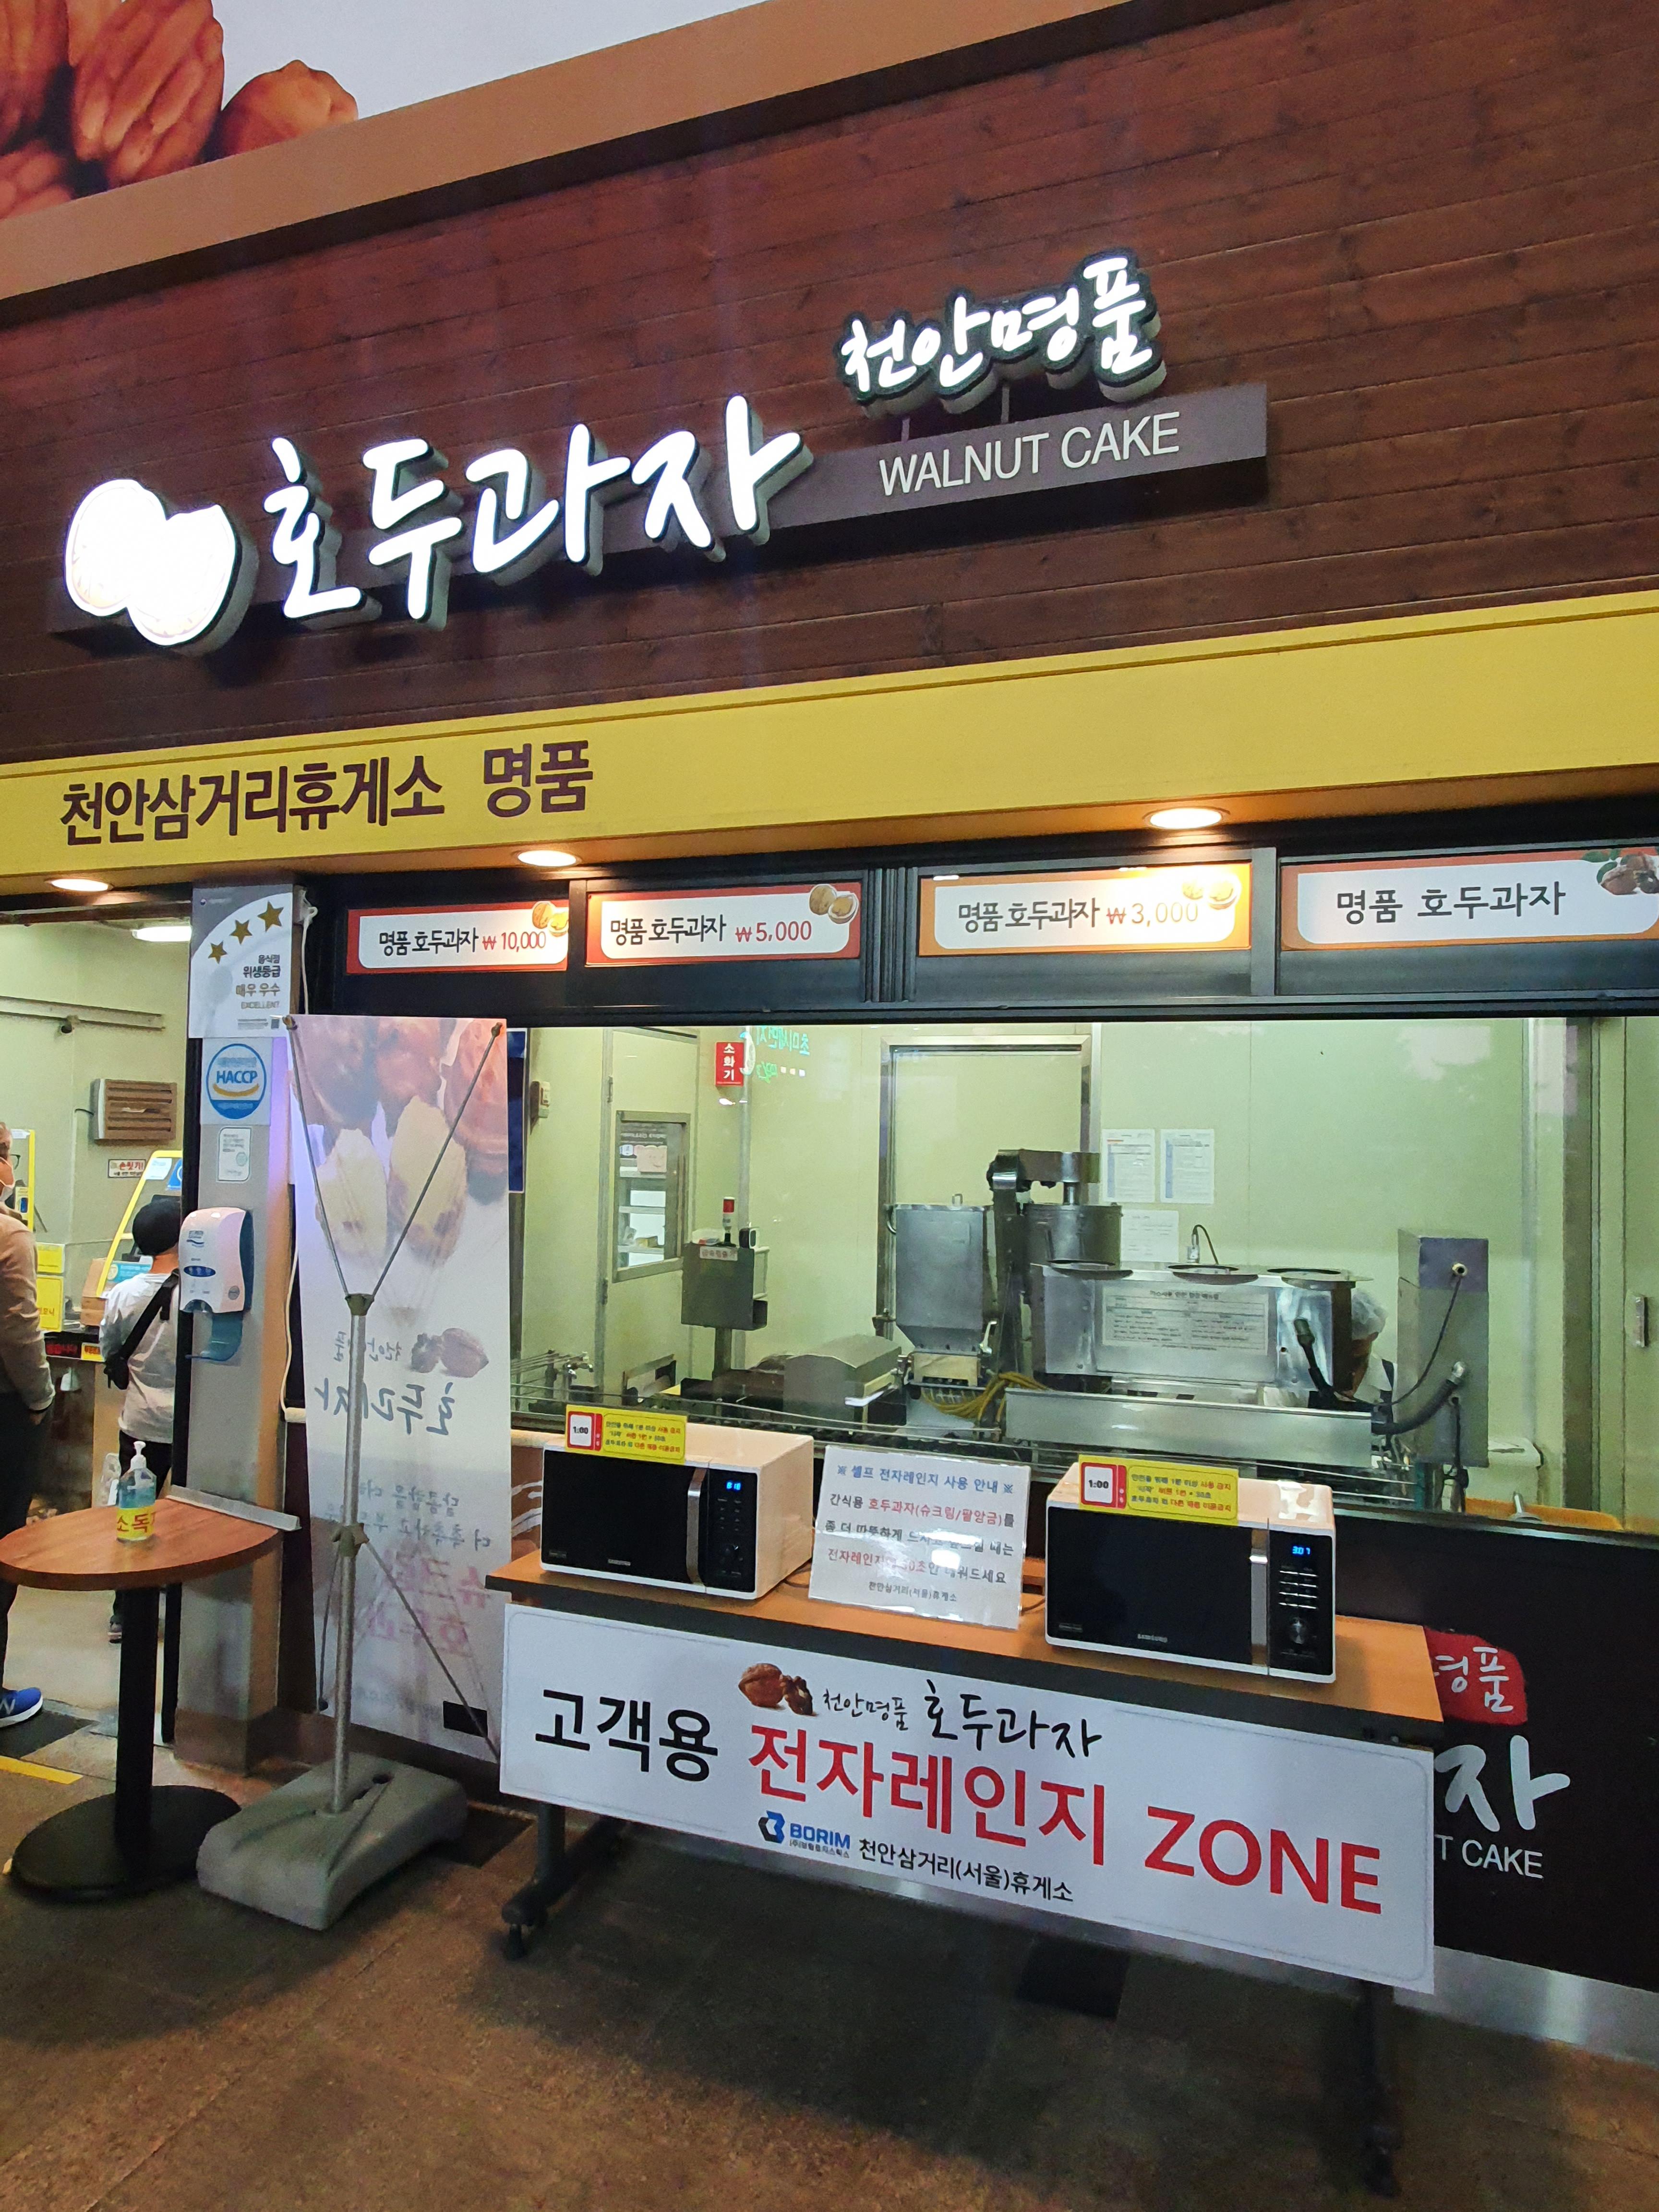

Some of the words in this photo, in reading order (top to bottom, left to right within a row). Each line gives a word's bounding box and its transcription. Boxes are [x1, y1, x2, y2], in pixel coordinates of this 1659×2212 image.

[840, 257, 1153, 393] 천안명품
[879, 433, 1049, 496] WALNUT
[1061, 411, 1180, 469] CAKE
[263, 395, 802, 620] 호두과자
[60, 755, 445, 846] 천안삼거리휴게소
[484, 740, 594, 818] 명품
[958, 902, 1003, 933] 명품
[1005, 897, 1100, 930] 호두과자
[1337, 890, 1403, 925] 명품
[1417, 881, 1566, 919] 호두과자
[379, 930, 411, 956] 명품
[412, 927, 479, 954] 호두과자
[610, 918, 647, 946] 명품
[649, 914, 727, 944] 호두과자
[243, 965, 281, 978] 위생등급
[259, 983, 280, 997] 우수
[216, 1070, 258, 1084] HACCP
[723, 1043, 736, 1081] 소화기
[851, 1465, 874, 1479] 셀프
[879, 1468, 939, 1486] 전자레인지
[944, 1475, 969, 1491] 사용
[974, 1478, 998, 1494] 안내
[1088, 1479, 1109, 1489] 1:00
[830, 1493, 863, 1509] 간식용
[841, 1522, 851, 1533] 더
[822, 1688, 909, 1731] 천안명품
[923, 1679, 1103, 1759] 호두과자
[535, 1689, 718, 1782] 고객용
[748, 1724, 1105, 1866] 전자레인지
[1144, 1806, 1382, 1914] ZONE
[790, 1823, 851, 1850] BORIM
[858, 1838, 1074, 1903] 천안삼거리(서울)휴게소
[1462, 1839, 1544, 1879] CAKE
